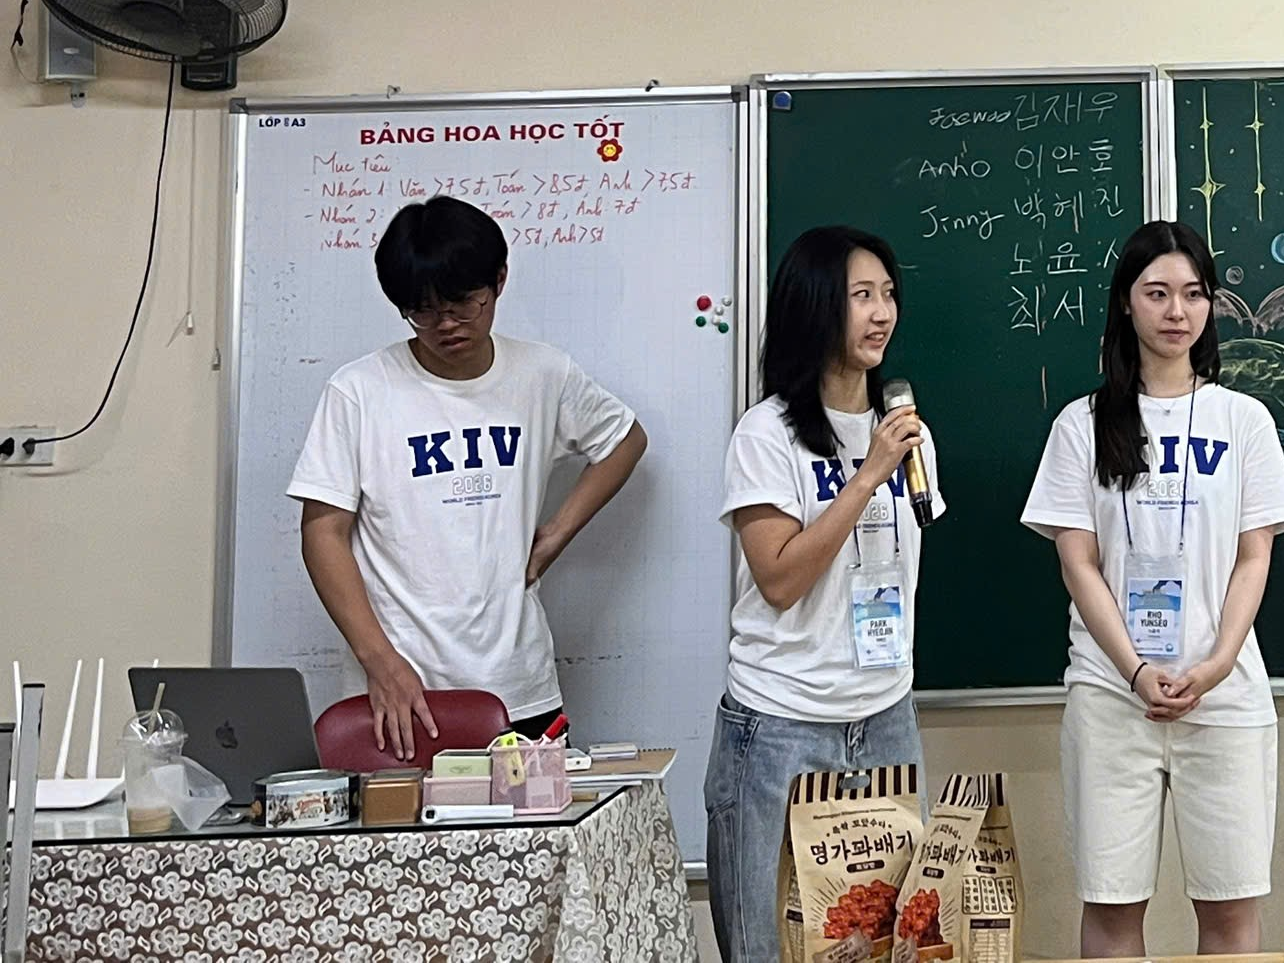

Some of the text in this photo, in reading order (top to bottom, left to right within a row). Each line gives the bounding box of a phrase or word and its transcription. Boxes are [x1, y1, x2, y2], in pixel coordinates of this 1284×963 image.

[360, 114, 625, 145] BẢNG HOA HỌC TỐT
[1014, 90, 1118, 131] 김재우
[1015, 139, 1114, 178] 이안호
[920, 205, 1005, 239] Jinny
[1008, 285, 1111, 337] 최서
[408, 426, 521, 477] KIV
[1140, 435, 1229, 476] IV
[811, 458, 906, 501] KV
[861, 502, 889, 522] 026
